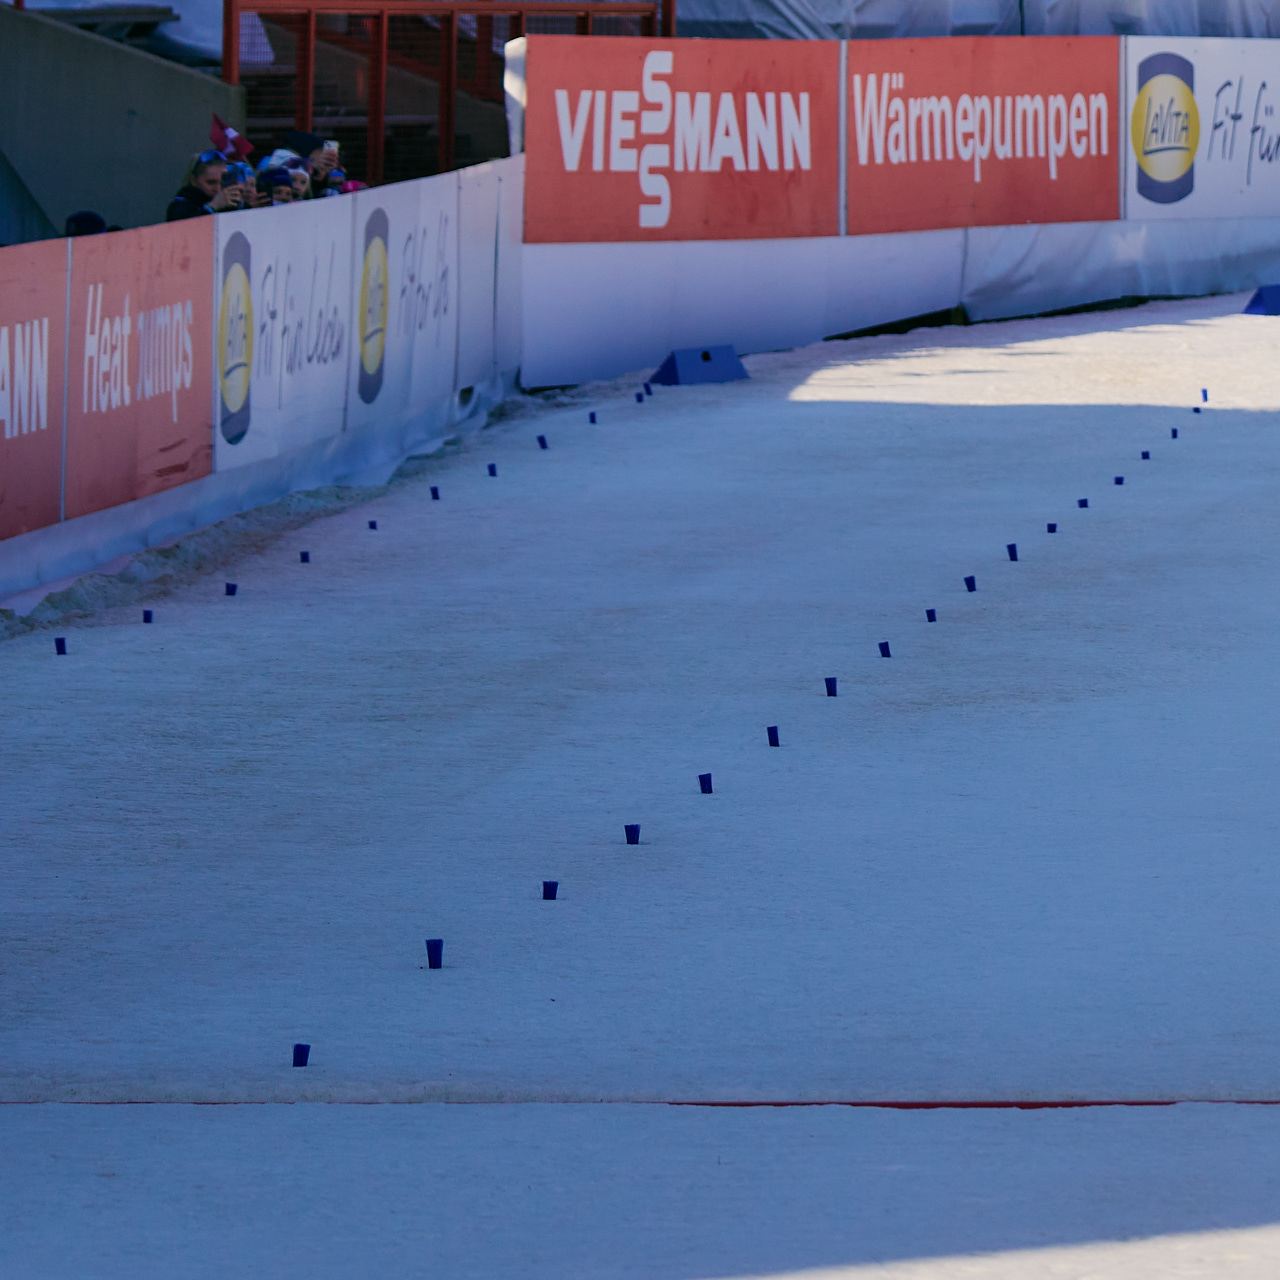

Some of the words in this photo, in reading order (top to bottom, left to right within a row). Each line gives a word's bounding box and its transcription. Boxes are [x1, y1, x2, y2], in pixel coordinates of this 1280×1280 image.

[554, 50, 812, 228] VIESSMANN
[852, 72, 1109, 183] Wärmepumpen
[1207, 75, 1243, 161] Fit
[83, 284, 131, 414] Heat
